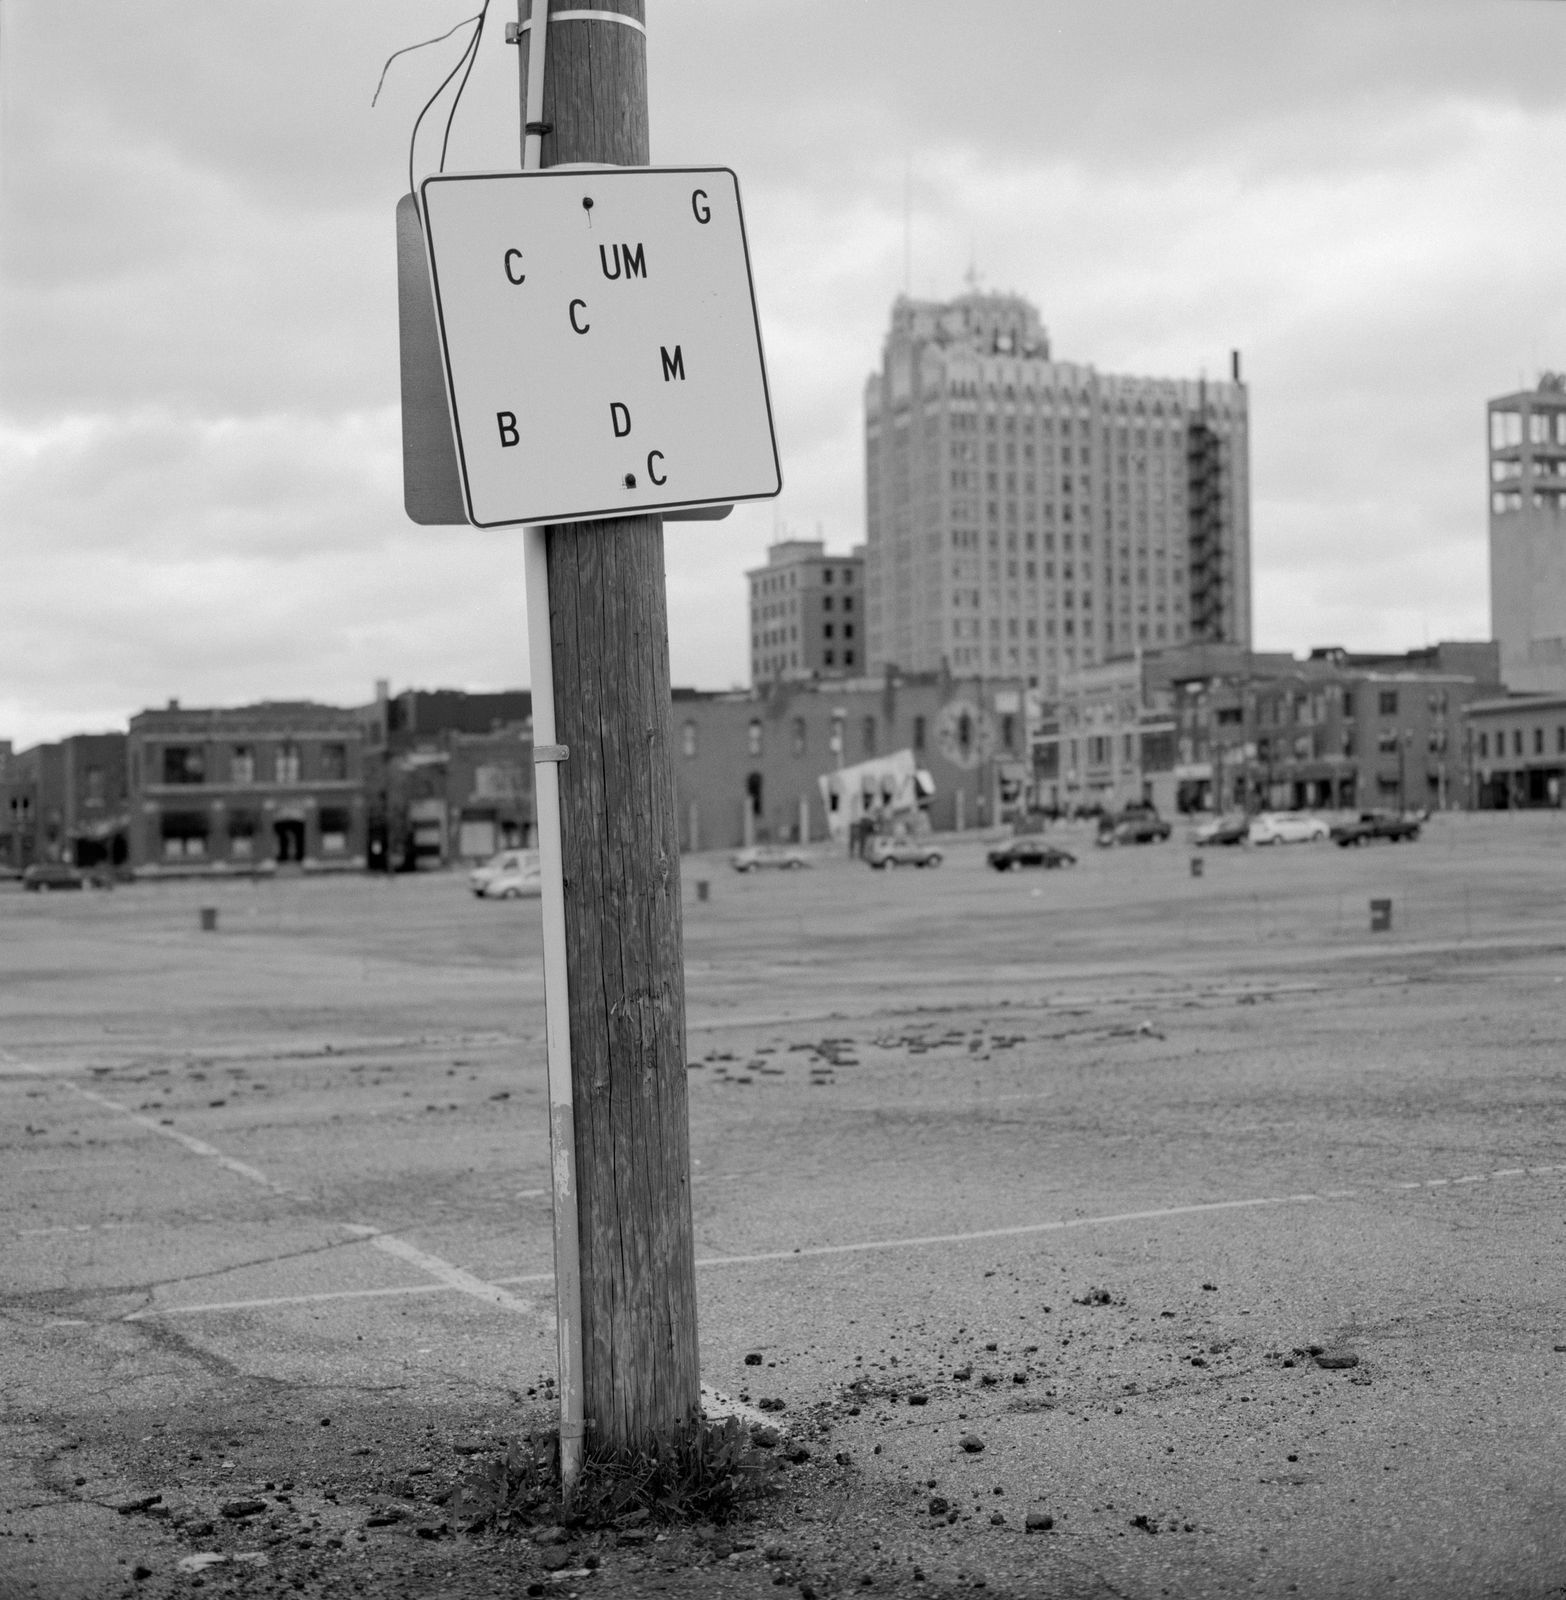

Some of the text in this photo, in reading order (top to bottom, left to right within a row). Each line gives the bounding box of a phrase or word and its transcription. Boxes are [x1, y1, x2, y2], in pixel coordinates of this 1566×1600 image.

[691, 189, 711, 225] G
[504, 242, 648, 286] C UM
[569, 298, 590, 335] C
[660, 345, 686, 382] M
[496, 402, 632, 448] B D
[647, 450, 667, 486] C
